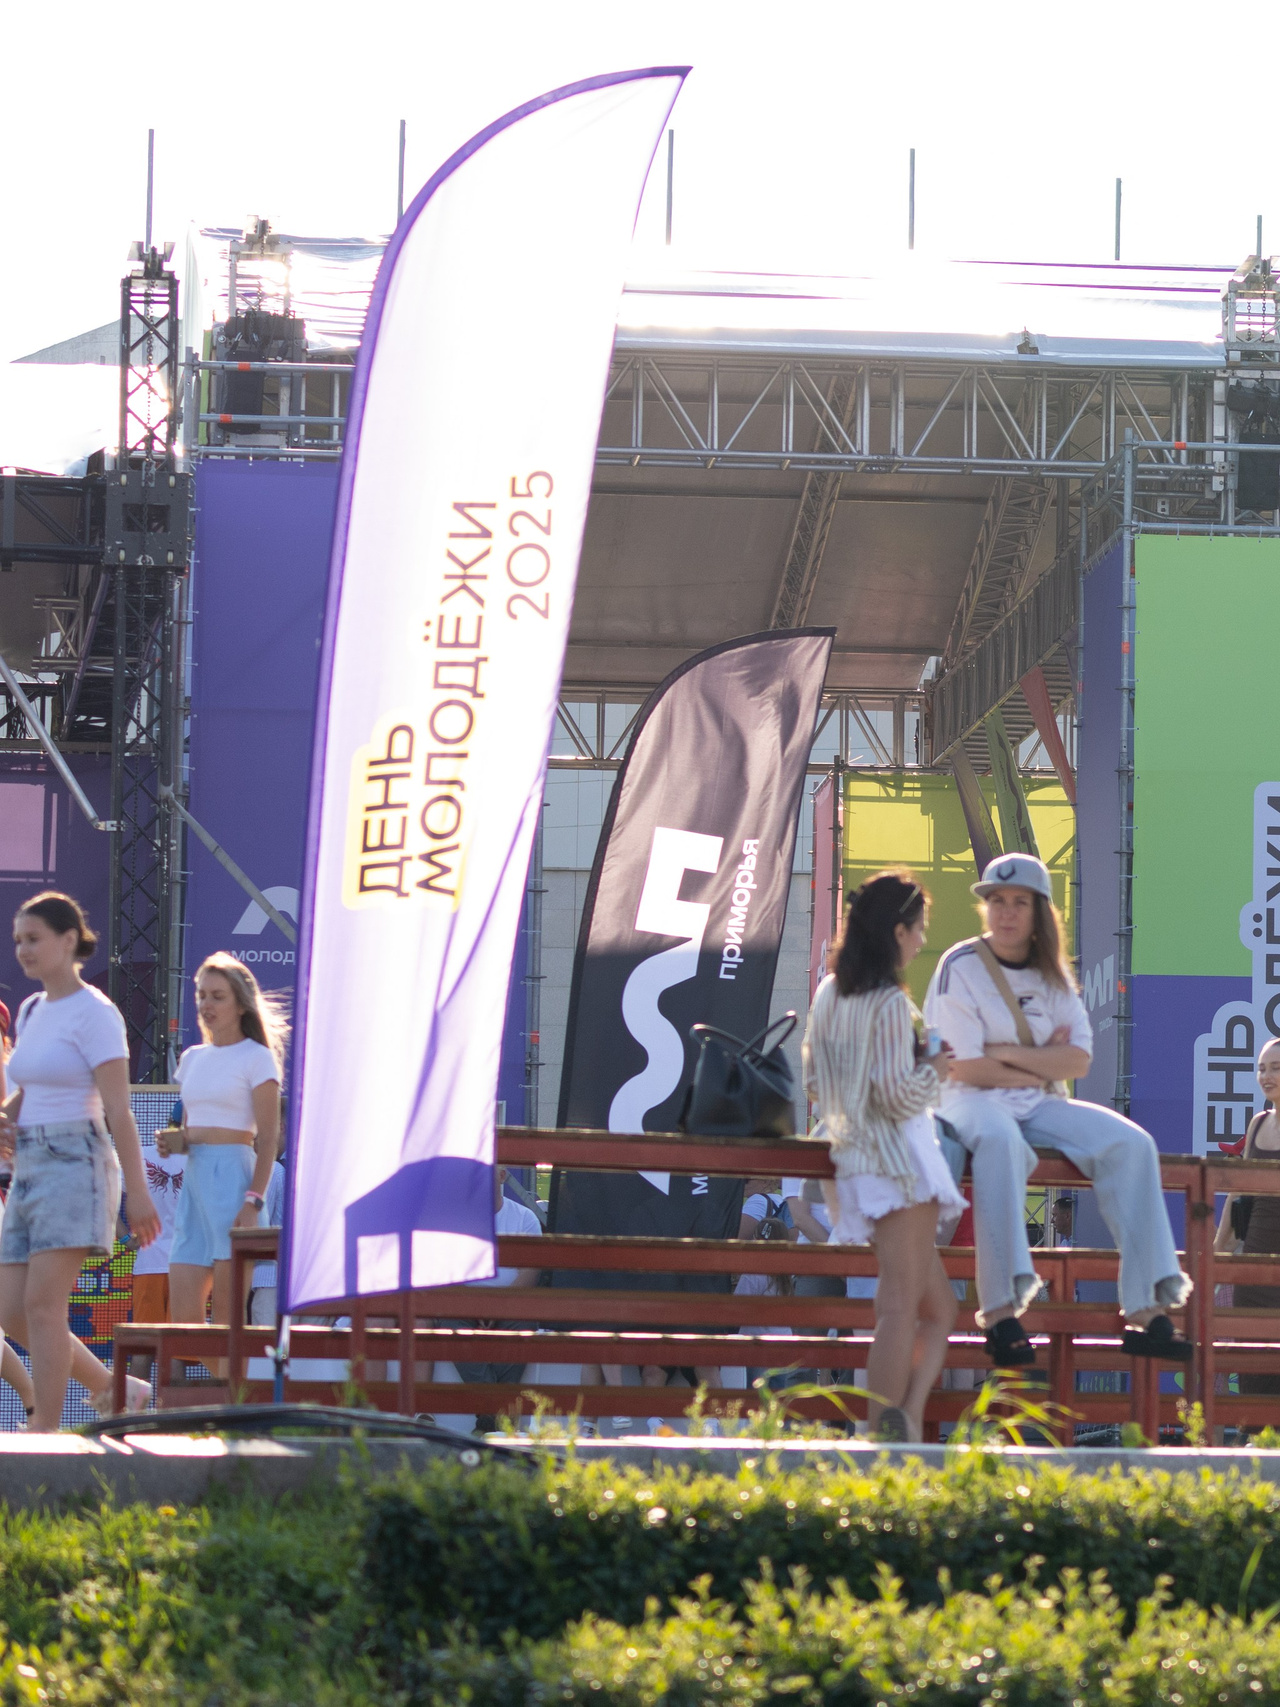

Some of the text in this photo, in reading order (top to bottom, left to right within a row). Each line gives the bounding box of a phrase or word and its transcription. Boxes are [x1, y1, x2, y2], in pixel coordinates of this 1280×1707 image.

[506, 470, 554, 620] 2025
[415, 501, 497, 897] МОЛОДЁЖИ
[358, 722, 415, 898] ДЕНЬ
[719, 838, 760, 981] приморья
[1206, 1015, 1255, 1158] ЕНЬ
